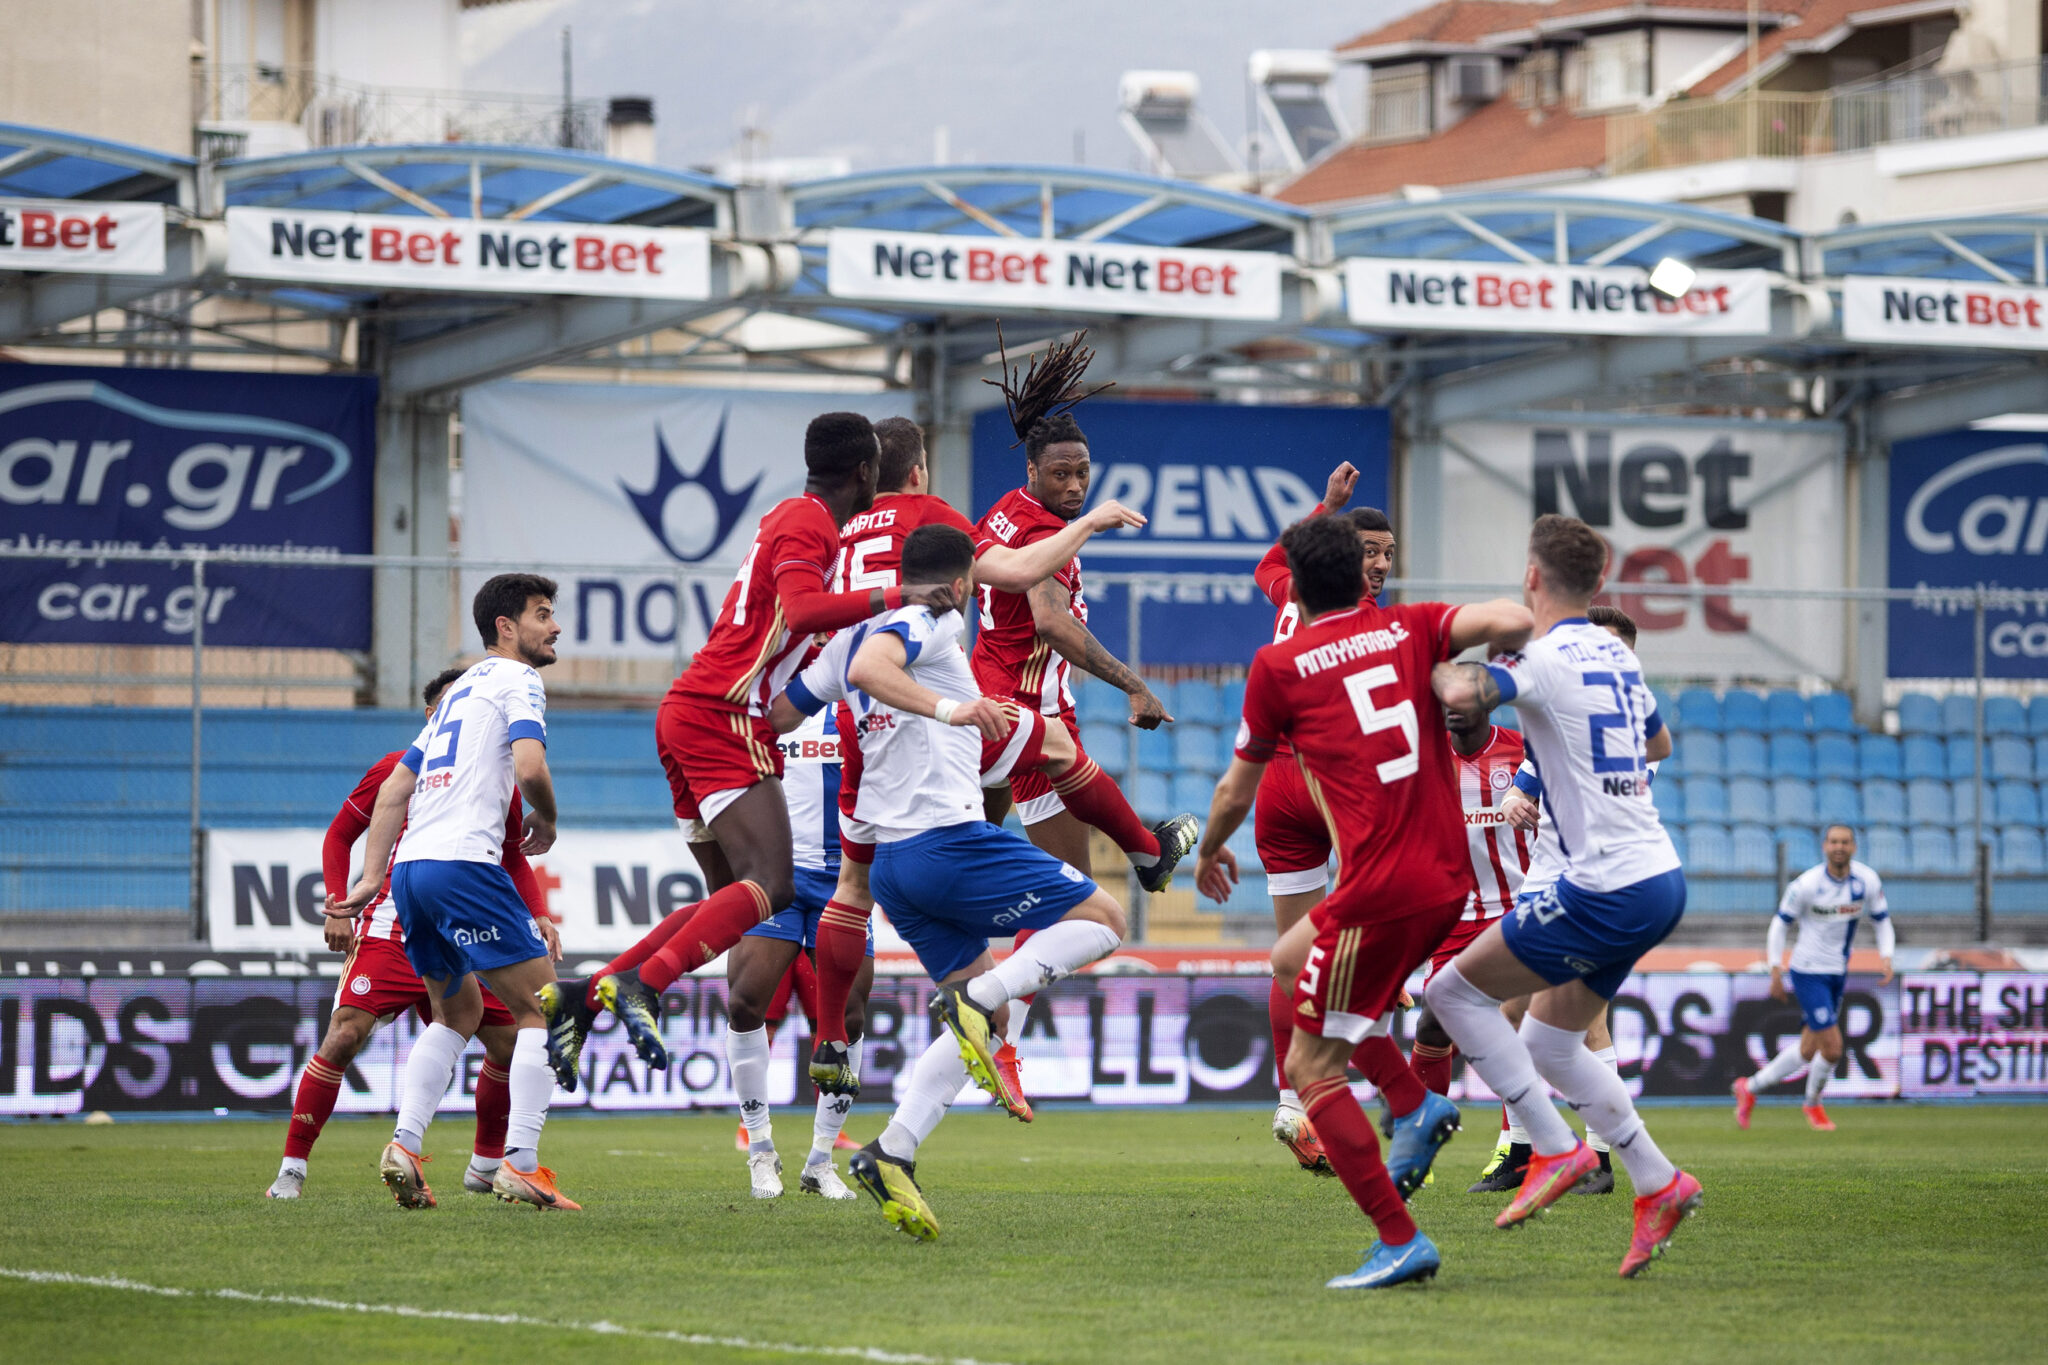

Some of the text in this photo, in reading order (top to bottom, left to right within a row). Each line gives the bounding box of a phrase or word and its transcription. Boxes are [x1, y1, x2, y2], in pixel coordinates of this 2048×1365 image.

[271, 221, 664, 274] NetBet NetBet
[873, 244, 1240, 295] NetBet NetBet
[1389, 272, 1555, 309] NetBet
[1883, 289, 2044, 329] NetBet
[0, 438, 303, 531] ar.gr
[1534, 429, 1751, 530] Net
[834, 535, 897, 594] 15
[1590, 537, 1750, 635] et
[38, 583, 237, 634] car.gr
[778, 740, 843, 758] etBe
[857, 712, 896, 741] etBet
[1343, 664, 1420, 784] 5
[1300, 945, 1326, 995] 5
[1907, 986, 1980, 1027] THE
